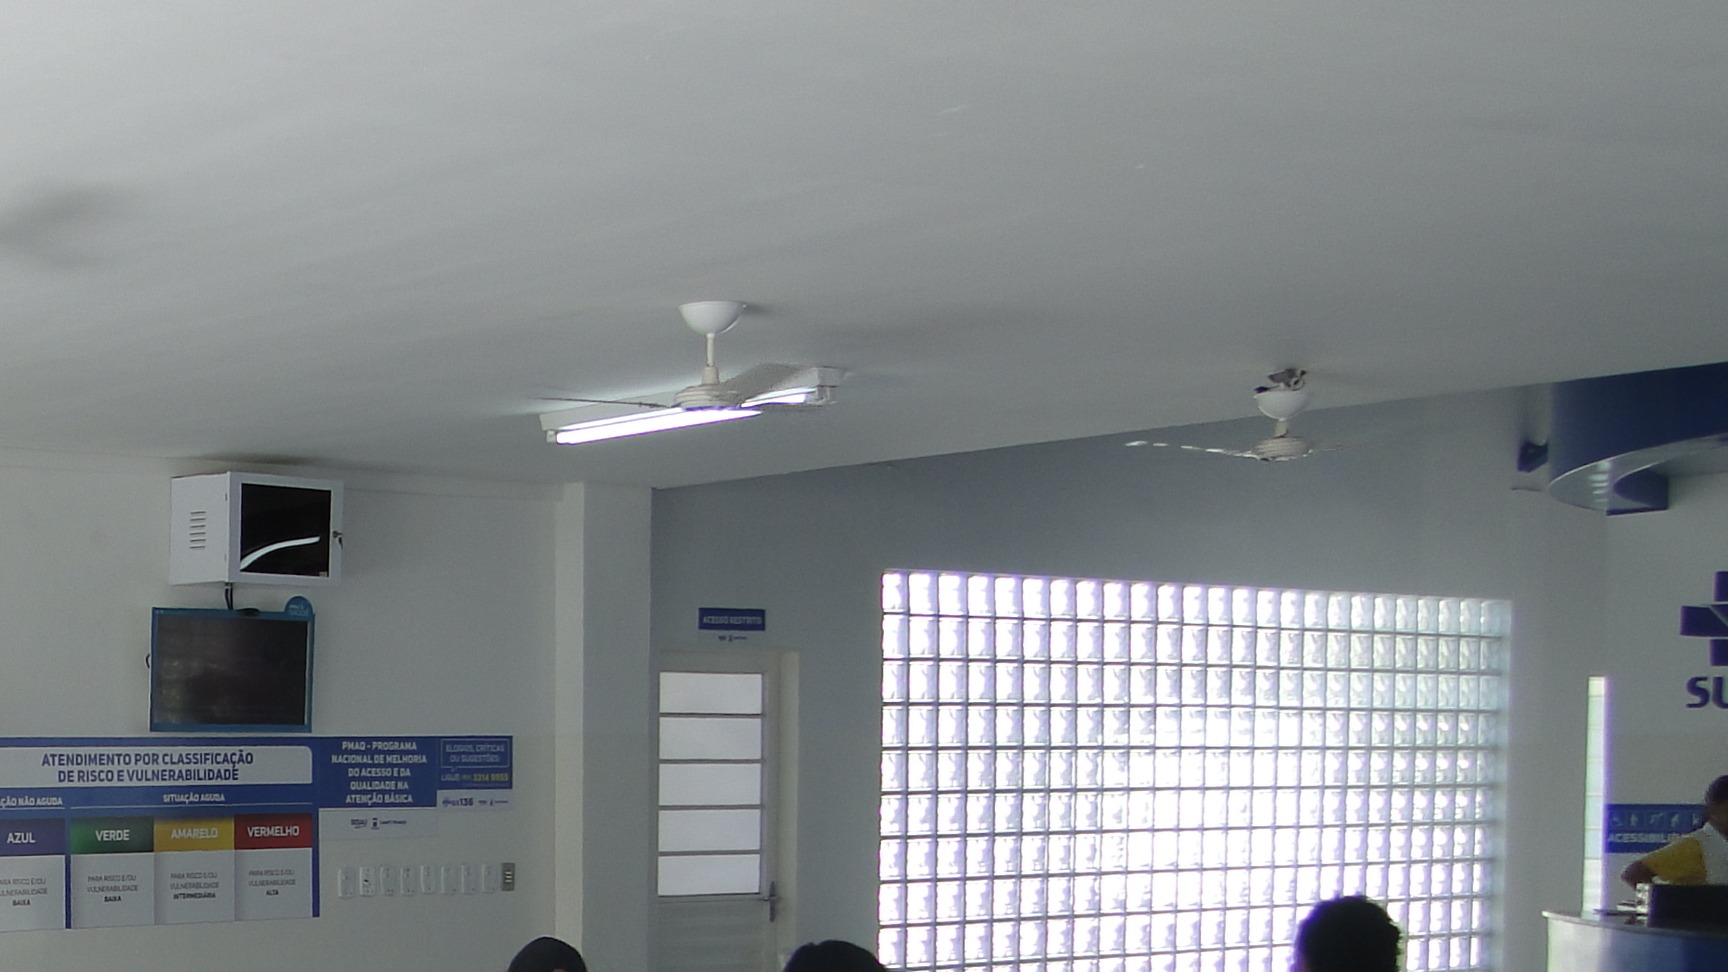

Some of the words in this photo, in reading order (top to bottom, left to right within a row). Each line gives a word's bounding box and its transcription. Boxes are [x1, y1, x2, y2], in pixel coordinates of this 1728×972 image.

[342, 741, 366, 750] PMAQ
[372, 741, 417, 750] PROGRAMA
[41, 753, 132, 767] ATENDIMENTO
[134, 753, 159, 766] POR
[162, 750, 254, 768] CLASSIFICAÇÃO
[331, 754, 373, 764] NACIONAL
[374, 754, 385, 763] DE
[386, 754, 427, 763] MELHORIA
[58, 770, 74, 783] DE
[78, 770, 114, 783] RISCO
[117, 770, 125, 782] E
[126, 769, 239, 782] VULNERABILIDADE
[348, 768, 360, 777] DO
[360, 768, 392, 777] ACESSO
[393, 768, 399, 776] E
[400, 768, 411, 776] DA
[350, 781, 396, 790] QUALIDADE
[397, 781, 409, 789] NA
[18, 796, 35, 806] NÃO
[36, 797, 63, 806] AGUDA
[163, 792, 200, 804] SITUAÇÃO
[200, 793, 225, 802] AGUDA
[345, 792, 383, 806] ATENÇÃO
[384, 792, 413, 803] BÁSICA
[6, 832, 36, 843] AZUL
[95, 829, 130, 841] VERDE
[171, 827, 218, 839] AMARELO
[247, 825, 300, 838] VERMELHO
